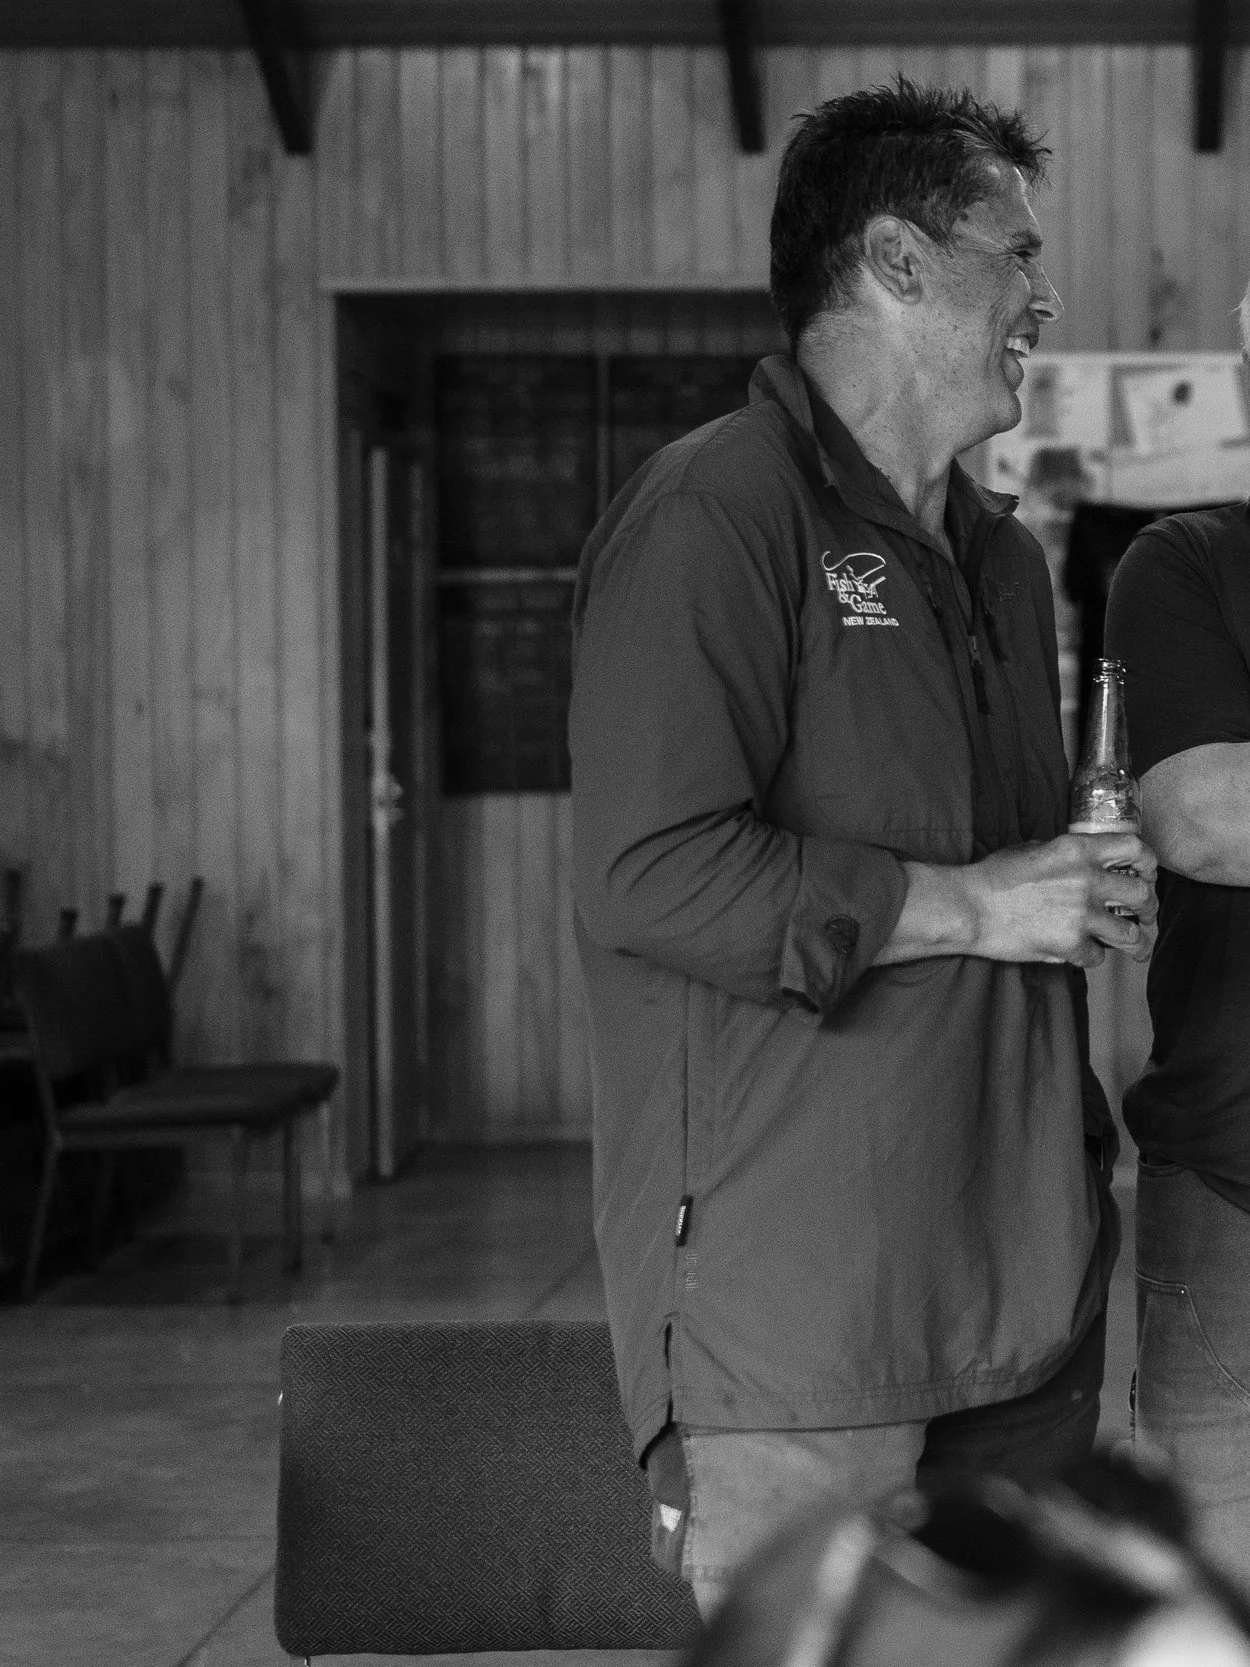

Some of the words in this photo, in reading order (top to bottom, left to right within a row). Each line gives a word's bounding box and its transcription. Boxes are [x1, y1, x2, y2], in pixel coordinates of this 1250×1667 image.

[826, 572, 855, 592] Fish
[839, 590, 851, 603] &
[850, 594, 887, 615] Game
[842, 616, 864, 626] NEW
[865, 616, 899, 627] ZEALAND
